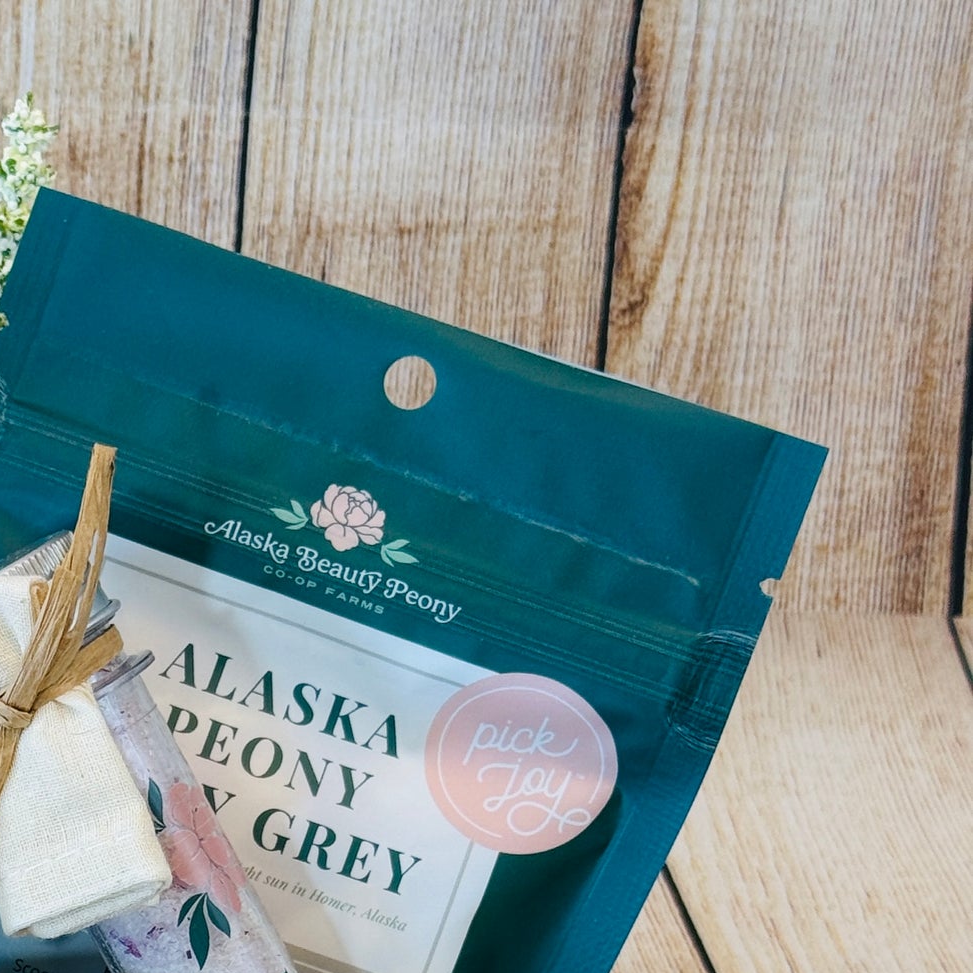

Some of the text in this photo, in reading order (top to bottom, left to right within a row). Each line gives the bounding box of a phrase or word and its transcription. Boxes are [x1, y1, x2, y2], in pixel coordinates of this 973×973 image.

[204, 519, 462, 623] Alaska Beauty Peony
[263, 564, 385, 614] CO-OP FARMS
[158, 643, 399, 759] ALASKA
[463, 717, 578, 766] pick
[166, 704, 374, 810] PEONY
[252, 808, 422, 895] GREY
[263, 875, 289, 892] sun
[291, 883, 308, 897] in
[360, 907, 408, 932] Alaska
